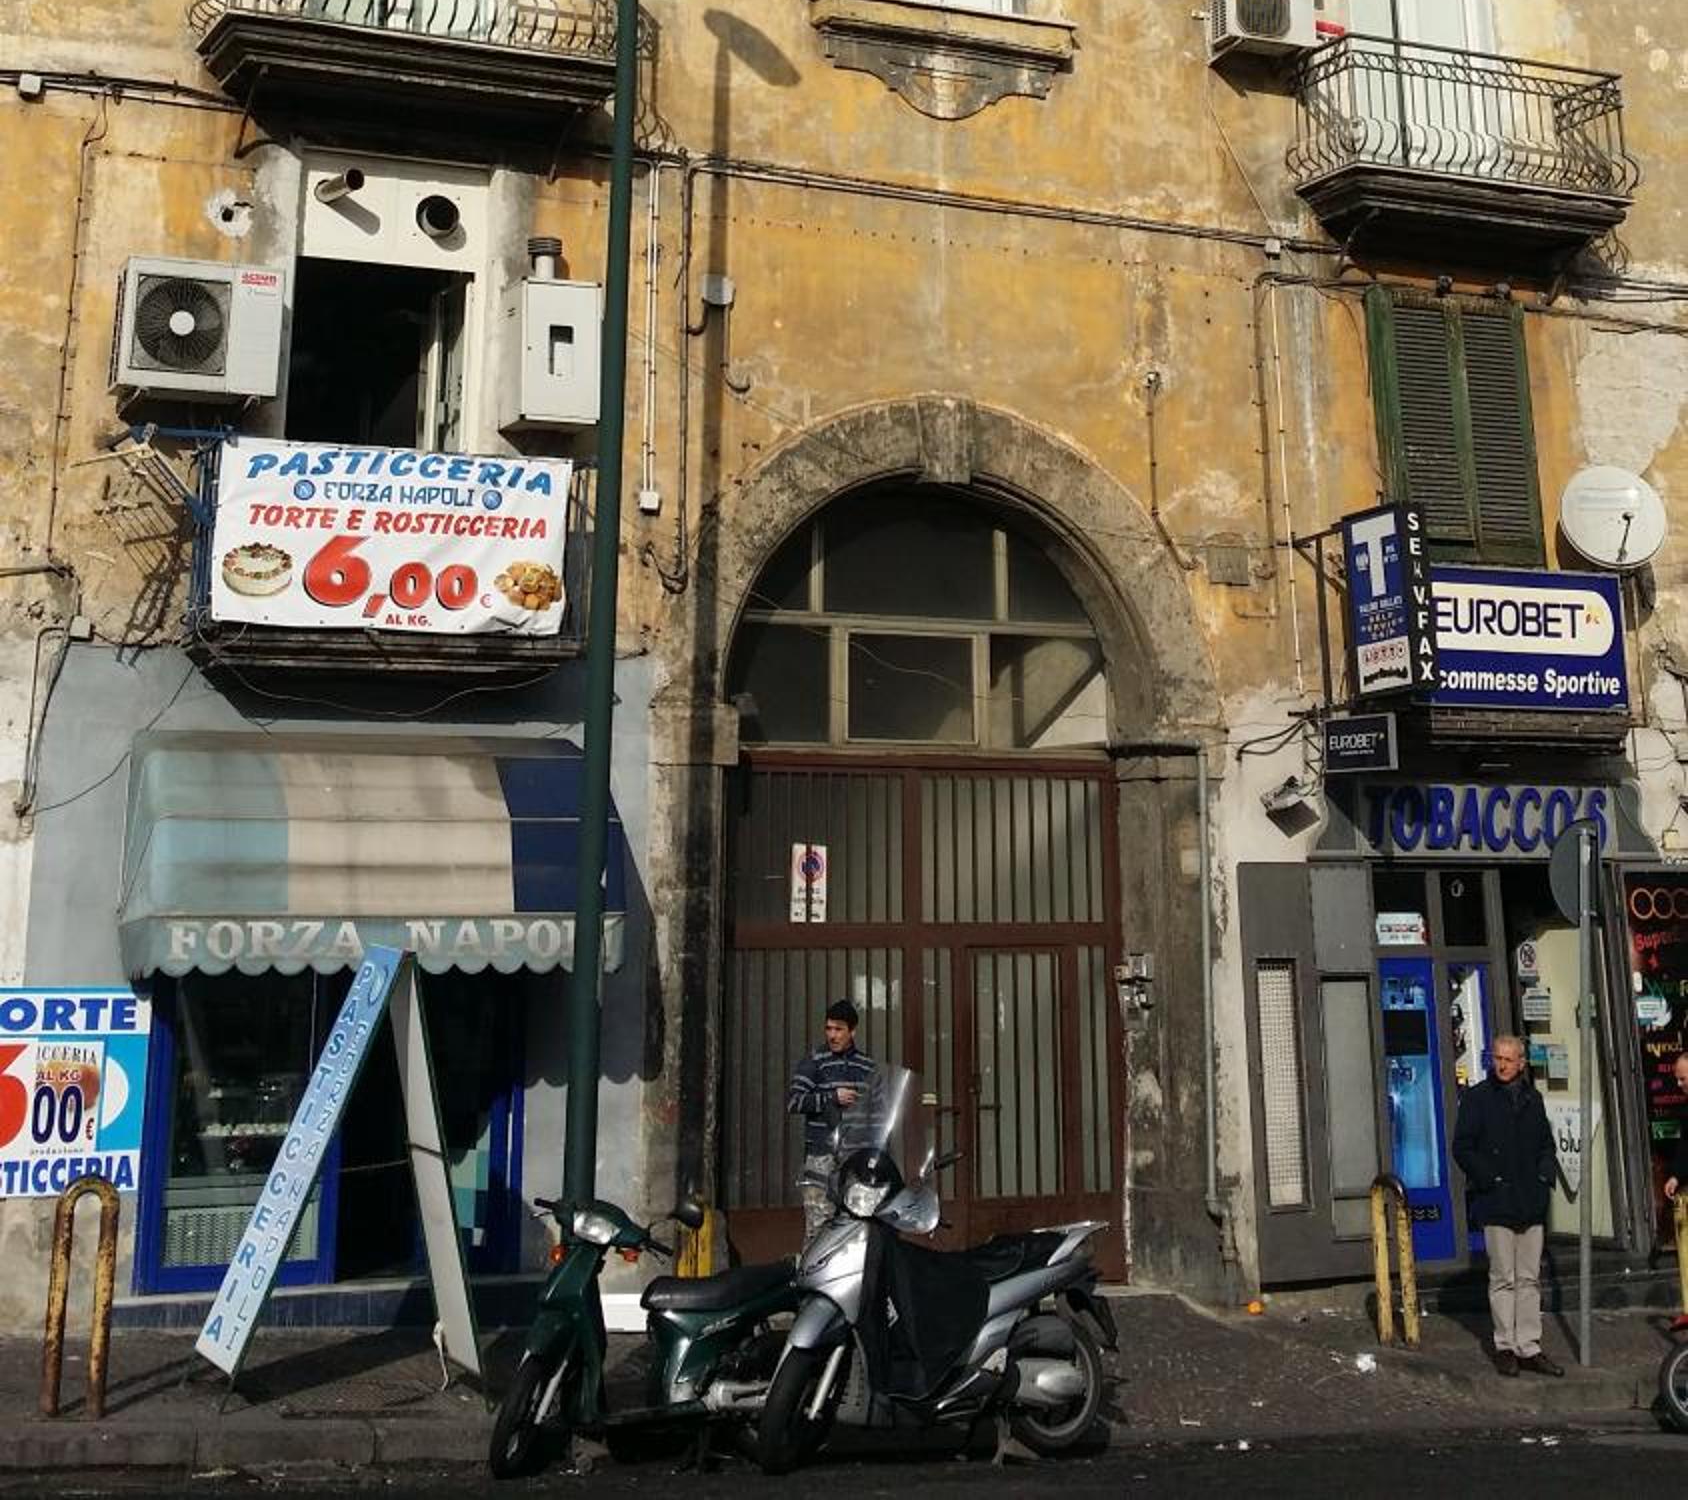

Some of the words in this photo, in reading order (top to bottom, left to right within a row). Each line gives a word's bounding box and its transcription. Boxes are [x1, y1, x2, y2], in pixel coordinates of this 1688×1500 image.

[247, 451, 552, 496] PASTICCERIA
[324, 481, 393, 503] FORZA
[249, 504, 338, 530] TORTE
[347, 509, 366, 531] E
[373, 511, 547, 540] ROSTICCERIA
[303, 534, 479, 618] 6,00
[385, 615, 403, 626] AL
[408, 615, 432, 627] KG.
[1432, 596, 1585, 640] EUROBET
[1439, 670, 1539, 692] commesse
[1544, 667, 1620, 698] Sportive
[166, 920, 365, 961] FORZA
[60, 1069, 81, 1081] KG
[205, 963, 374, 1342] PASTICCERIA
[0, 1156, 134, 1194] TICCERIA
